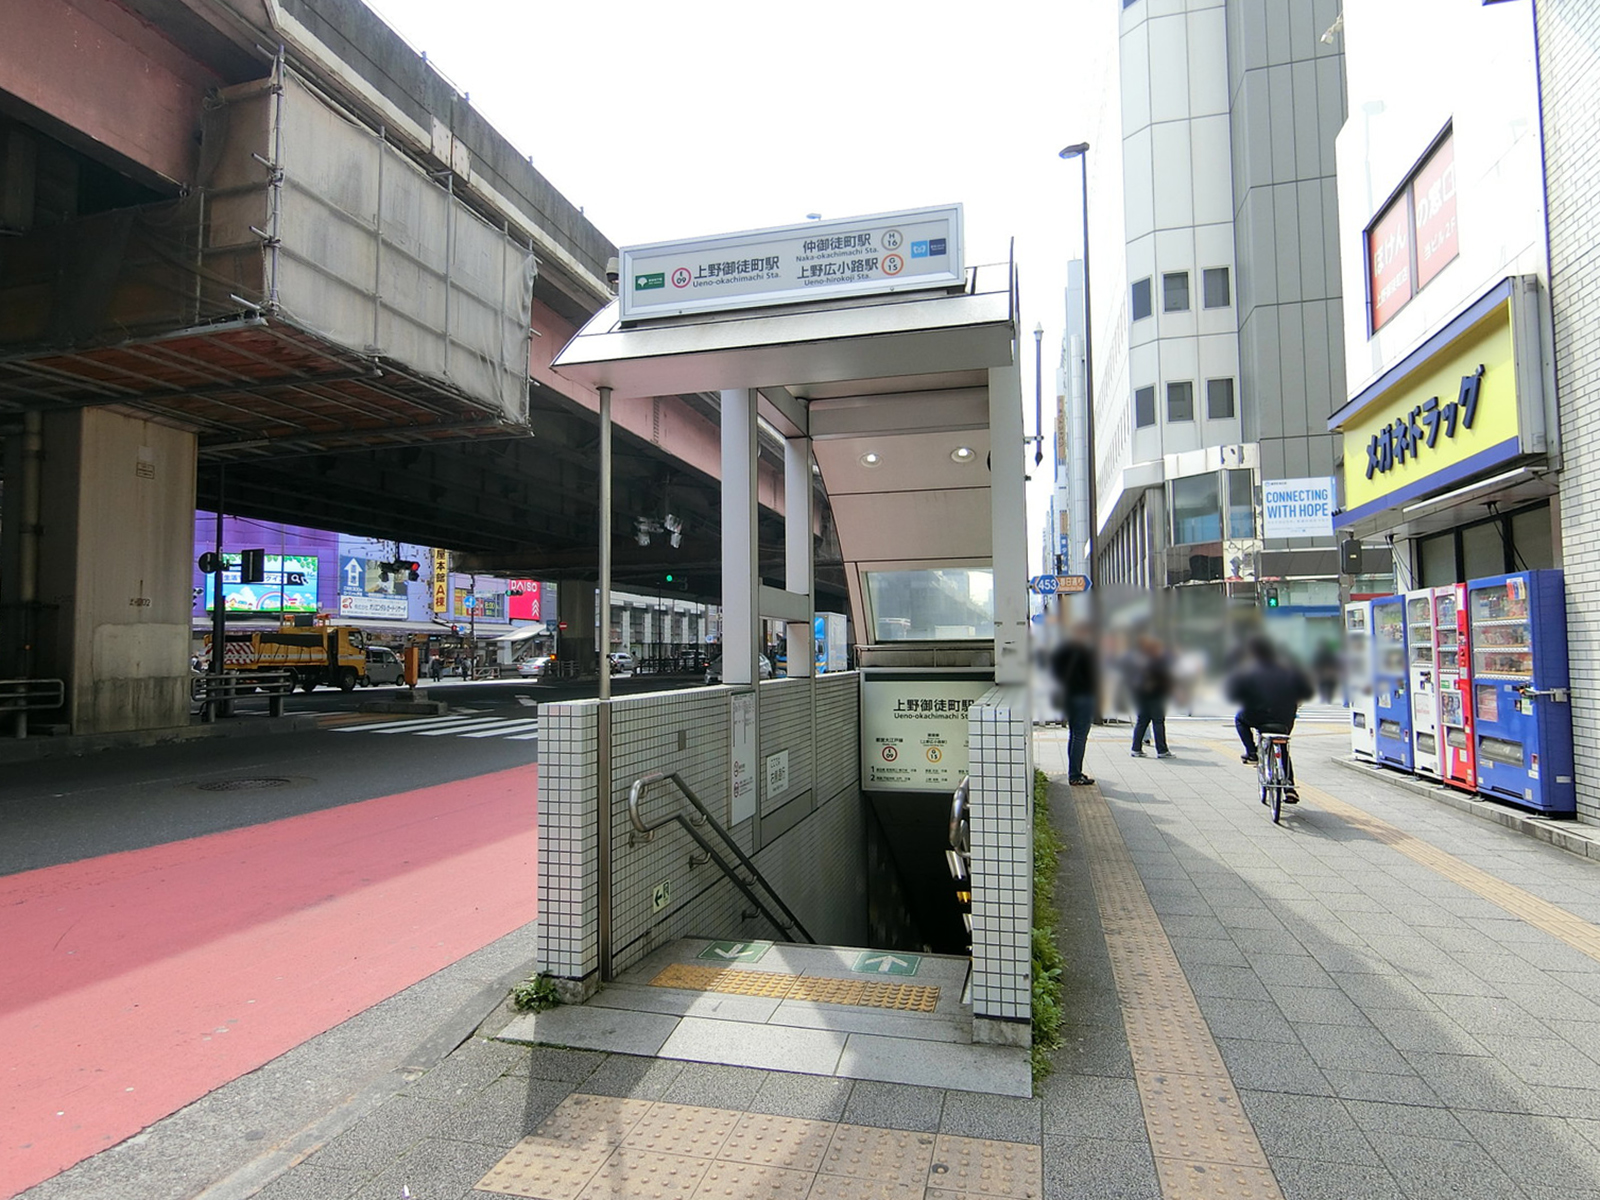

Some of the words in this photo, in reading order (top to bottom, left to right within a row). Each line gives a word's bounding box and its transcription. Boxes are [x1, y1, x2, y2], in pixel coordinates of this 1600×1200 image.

[803, 233, 871, 254] 仲御徒町駅
[887, 238, 898, 247] 16
[796, 249, 863, 262] Naka-okachimachi
[864, 246, 879, 254] Sta.
[693, 256, 780, 279] 上野御徒町駅
[797, 257, 879, 279] 上野広小路駅
[887, 263, 898, 271] 15
[676, 277, 686, 285] 09
[693, 272, 764, 288] Ueno-okachimachi
[766, 271, 782, 280] Sta.
[804, 275, 855, 287] Ueno-hirokoji
[856, 272, 872, 281] Sta.
[1365, 364, 1486, 481] メガネドラッグ
[1266, 489, 1328, 504] CONNECTING
[1267, 505, 1297, 519] WITH
[1299, 502, 1329, 517] HOPE
[511, 580, 538, 592] DAISO
[1038, 579, 1057, 590] 453
[893, 699, 975, 712] 上野御徒町駅
[894, 712, 959, 720] Ueno-okachimachi
[960, 712, 969, 720] St
